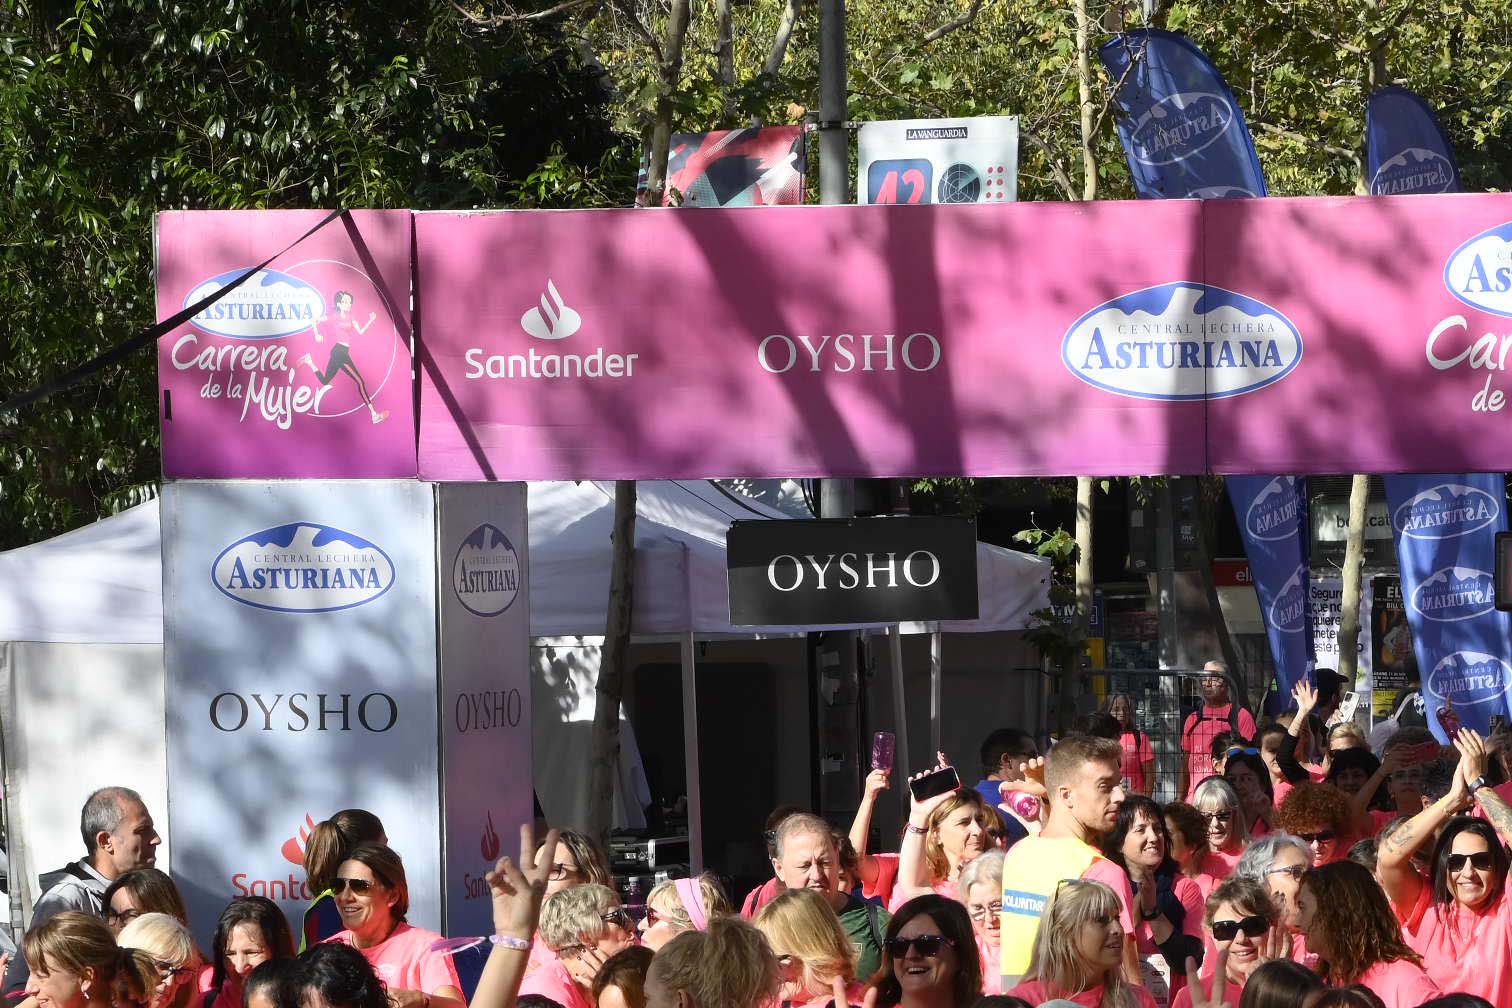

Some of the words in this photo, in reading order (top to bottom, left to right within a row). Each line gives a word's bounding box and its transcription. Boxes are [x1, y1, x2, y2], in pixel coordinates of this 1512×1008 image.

[1080, 326, 1284, 369] ASTURIANA
[1117, 323, 1193, 335] CENTRAL
[1200, 322, 1275, 334] LECHERA
[171, 334, 289, 371] Carrera
[465, 346, 639, 380] Santander
[757, 332, 942, 376] OYSHO
[200, 372, 222, 399] de
[227, 370, 243, 399] la
[240, 367, 333, 430] Mujer
[1471, 372, 1506, 413] de
[227, 556, 383, 590] ASTURIANA
[254, 554, 312, 564] CENTRAL
[318, 554, 376, 563] LECHERA
[458, 558, 517, 593] ASTURIANA
[767, 550, 941, 591] OYSHO
[209, 692, 398, 733] OYSHO
[455, 688, 522, 733] OYSHO
